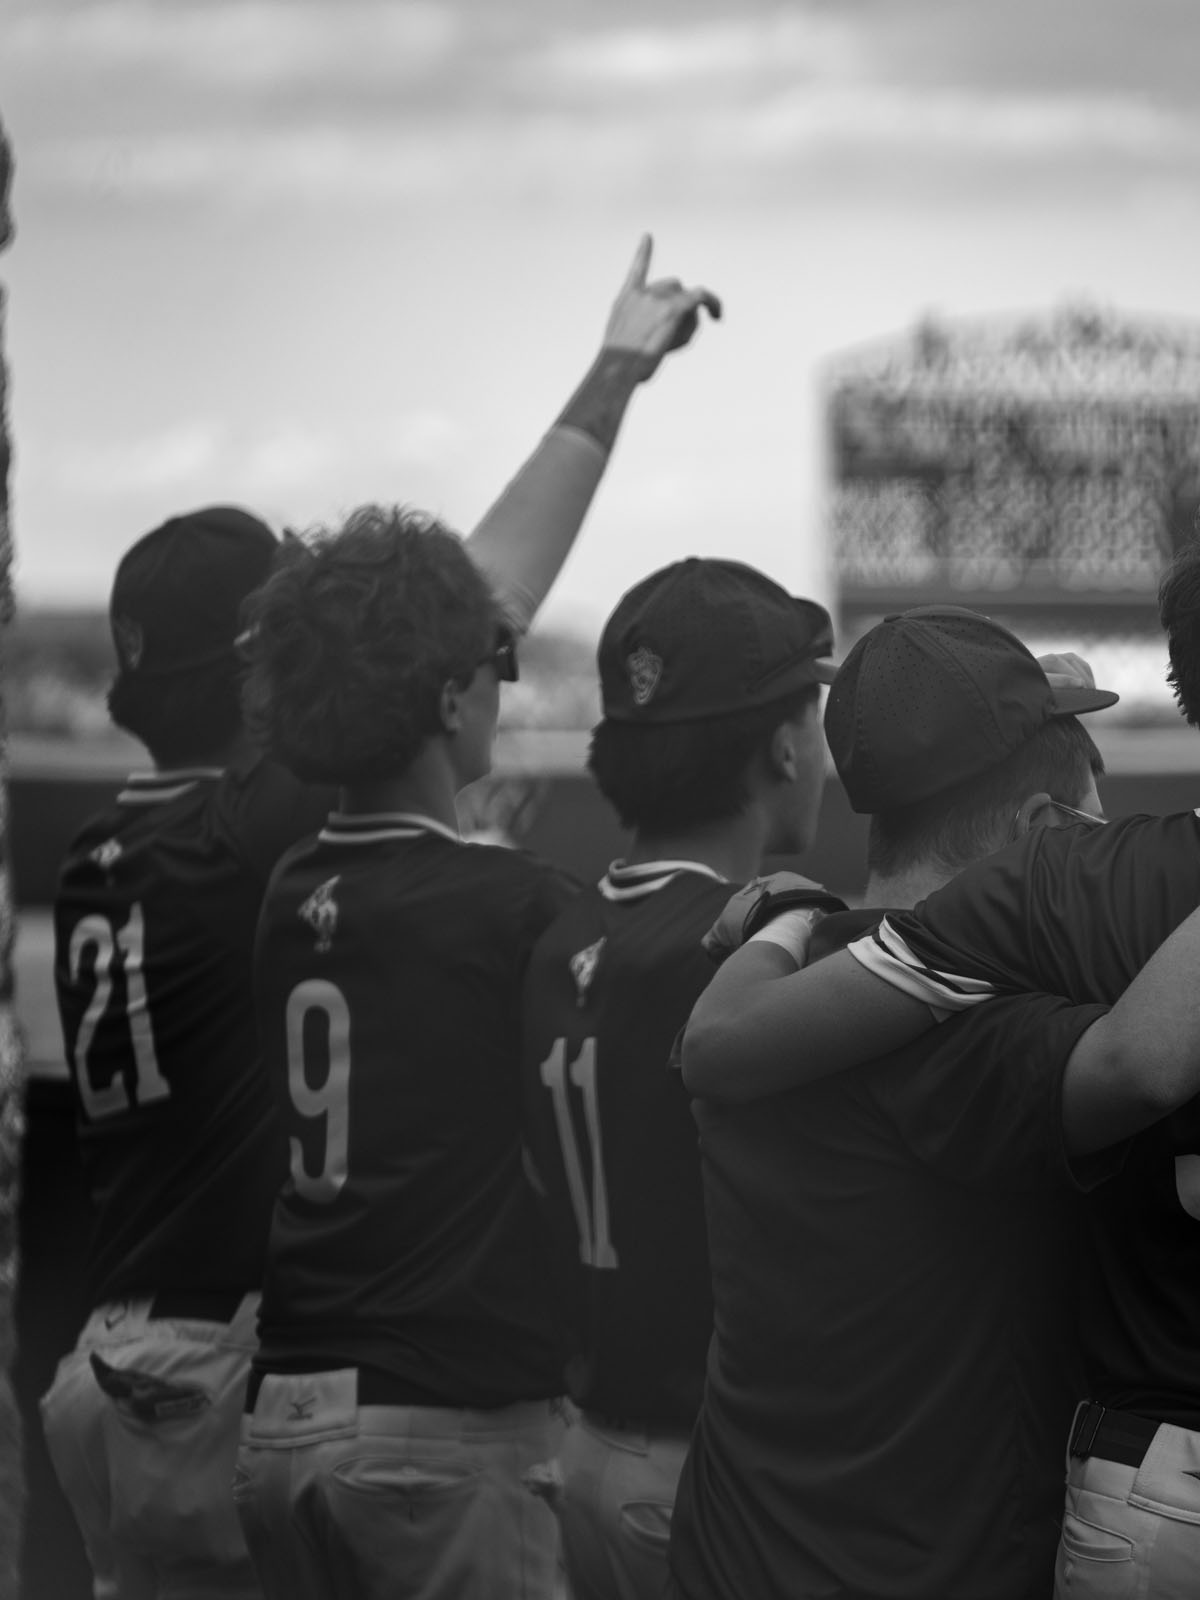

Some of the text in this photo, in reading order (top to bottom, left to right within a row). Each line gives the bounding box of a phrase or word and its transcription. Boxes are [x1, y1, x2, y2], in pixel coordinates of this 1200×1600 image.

[69, 901, 171, 1119] 21
[286, 978, 351, 1202] 9
[539, 1036, 619, 1269] 11
